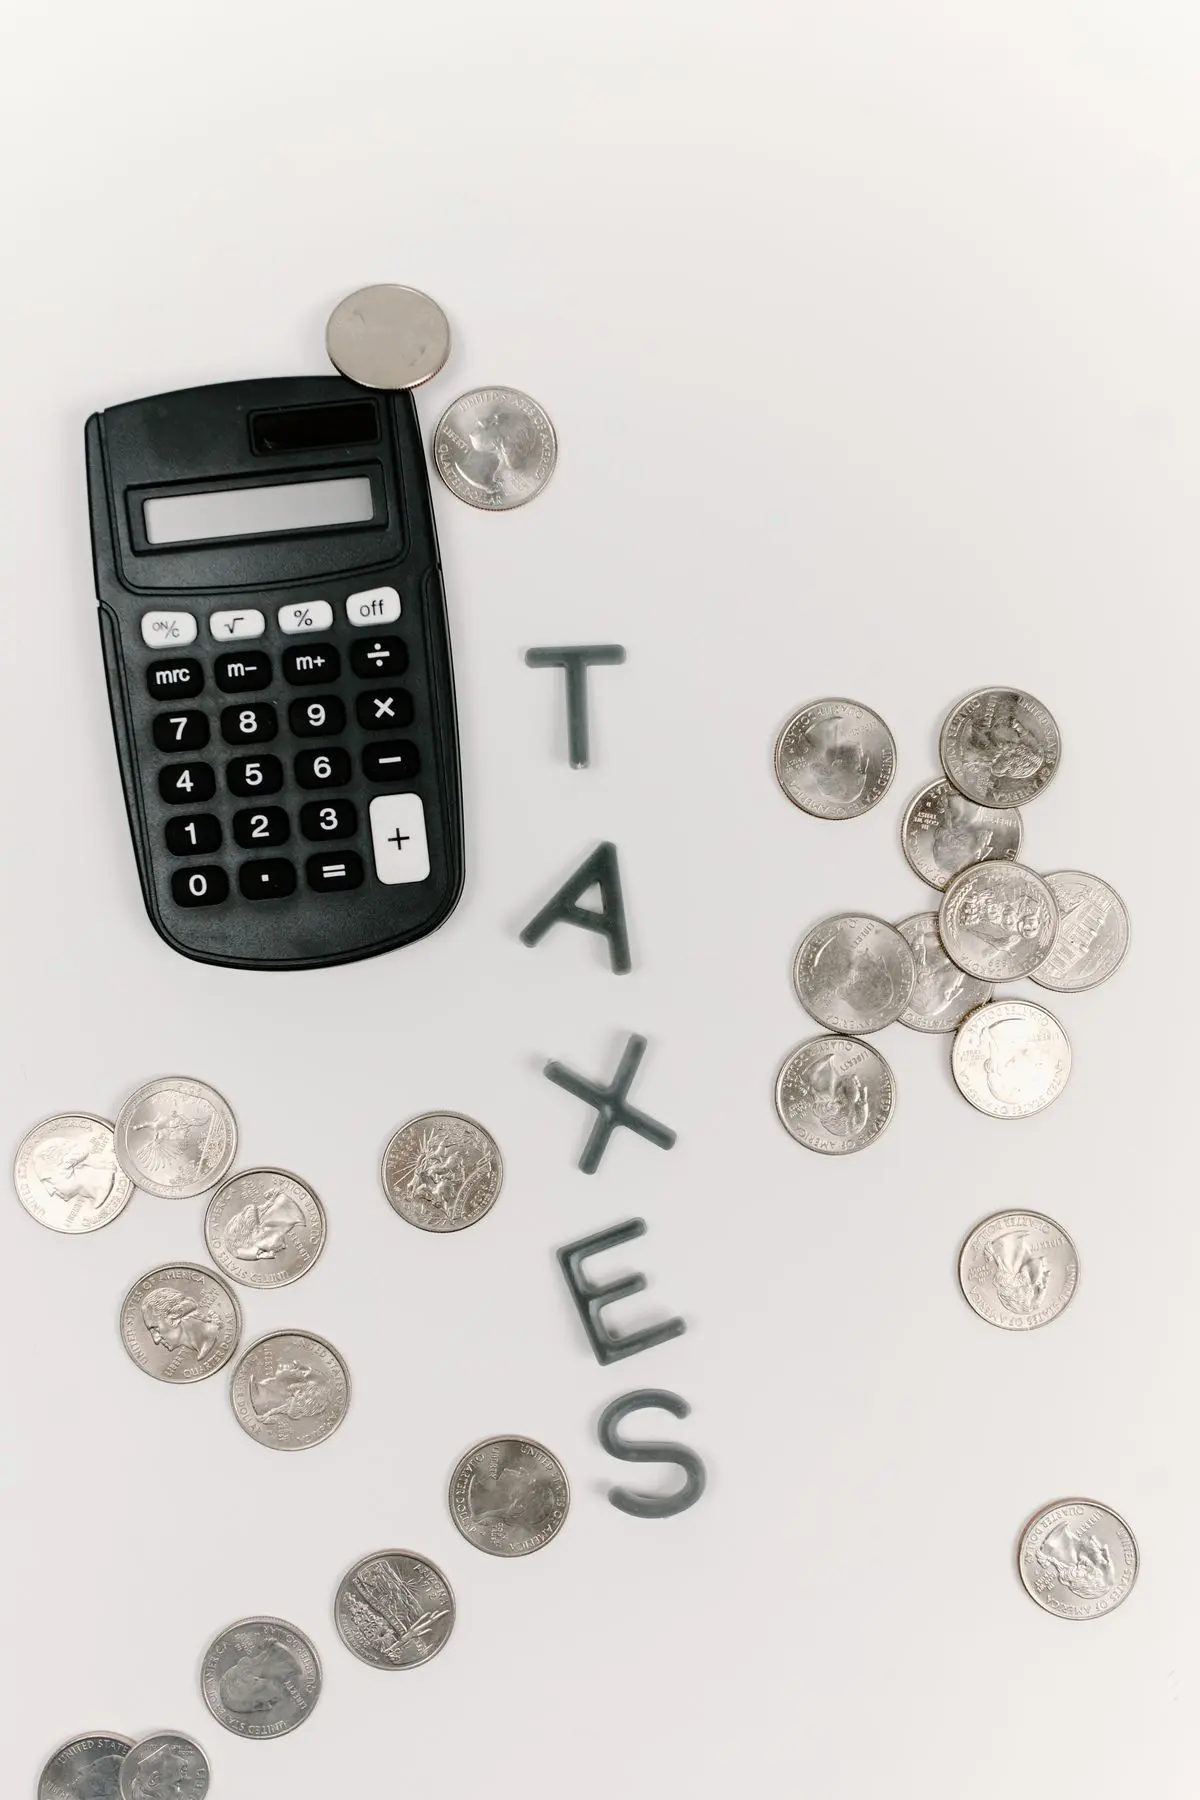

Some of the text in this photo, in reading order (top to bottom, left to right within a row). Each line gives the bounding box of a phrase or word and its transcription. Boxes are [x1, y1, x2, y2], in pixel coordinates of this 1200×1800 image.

[359, 599, 385, 617] off
[156, 669, 190, 684] mrc
[240, 711, 257, 733] 8
[308, 704, 325, 726] 9
[170, 718, 187, 740] 7
[246, 763, 262, 785] 5
[314, 757, 331, 778] 6
[177, 770, 193, 792] 4
[251, 815, 269, 837] 2
[320, 808, 337, 830] 3
[184, 823, 196, 844] 1
[189, 875, 207, 896] 0
[57, 1739, 94, 1764] UNITED
[97, 1739, 132, 1754] STATE
